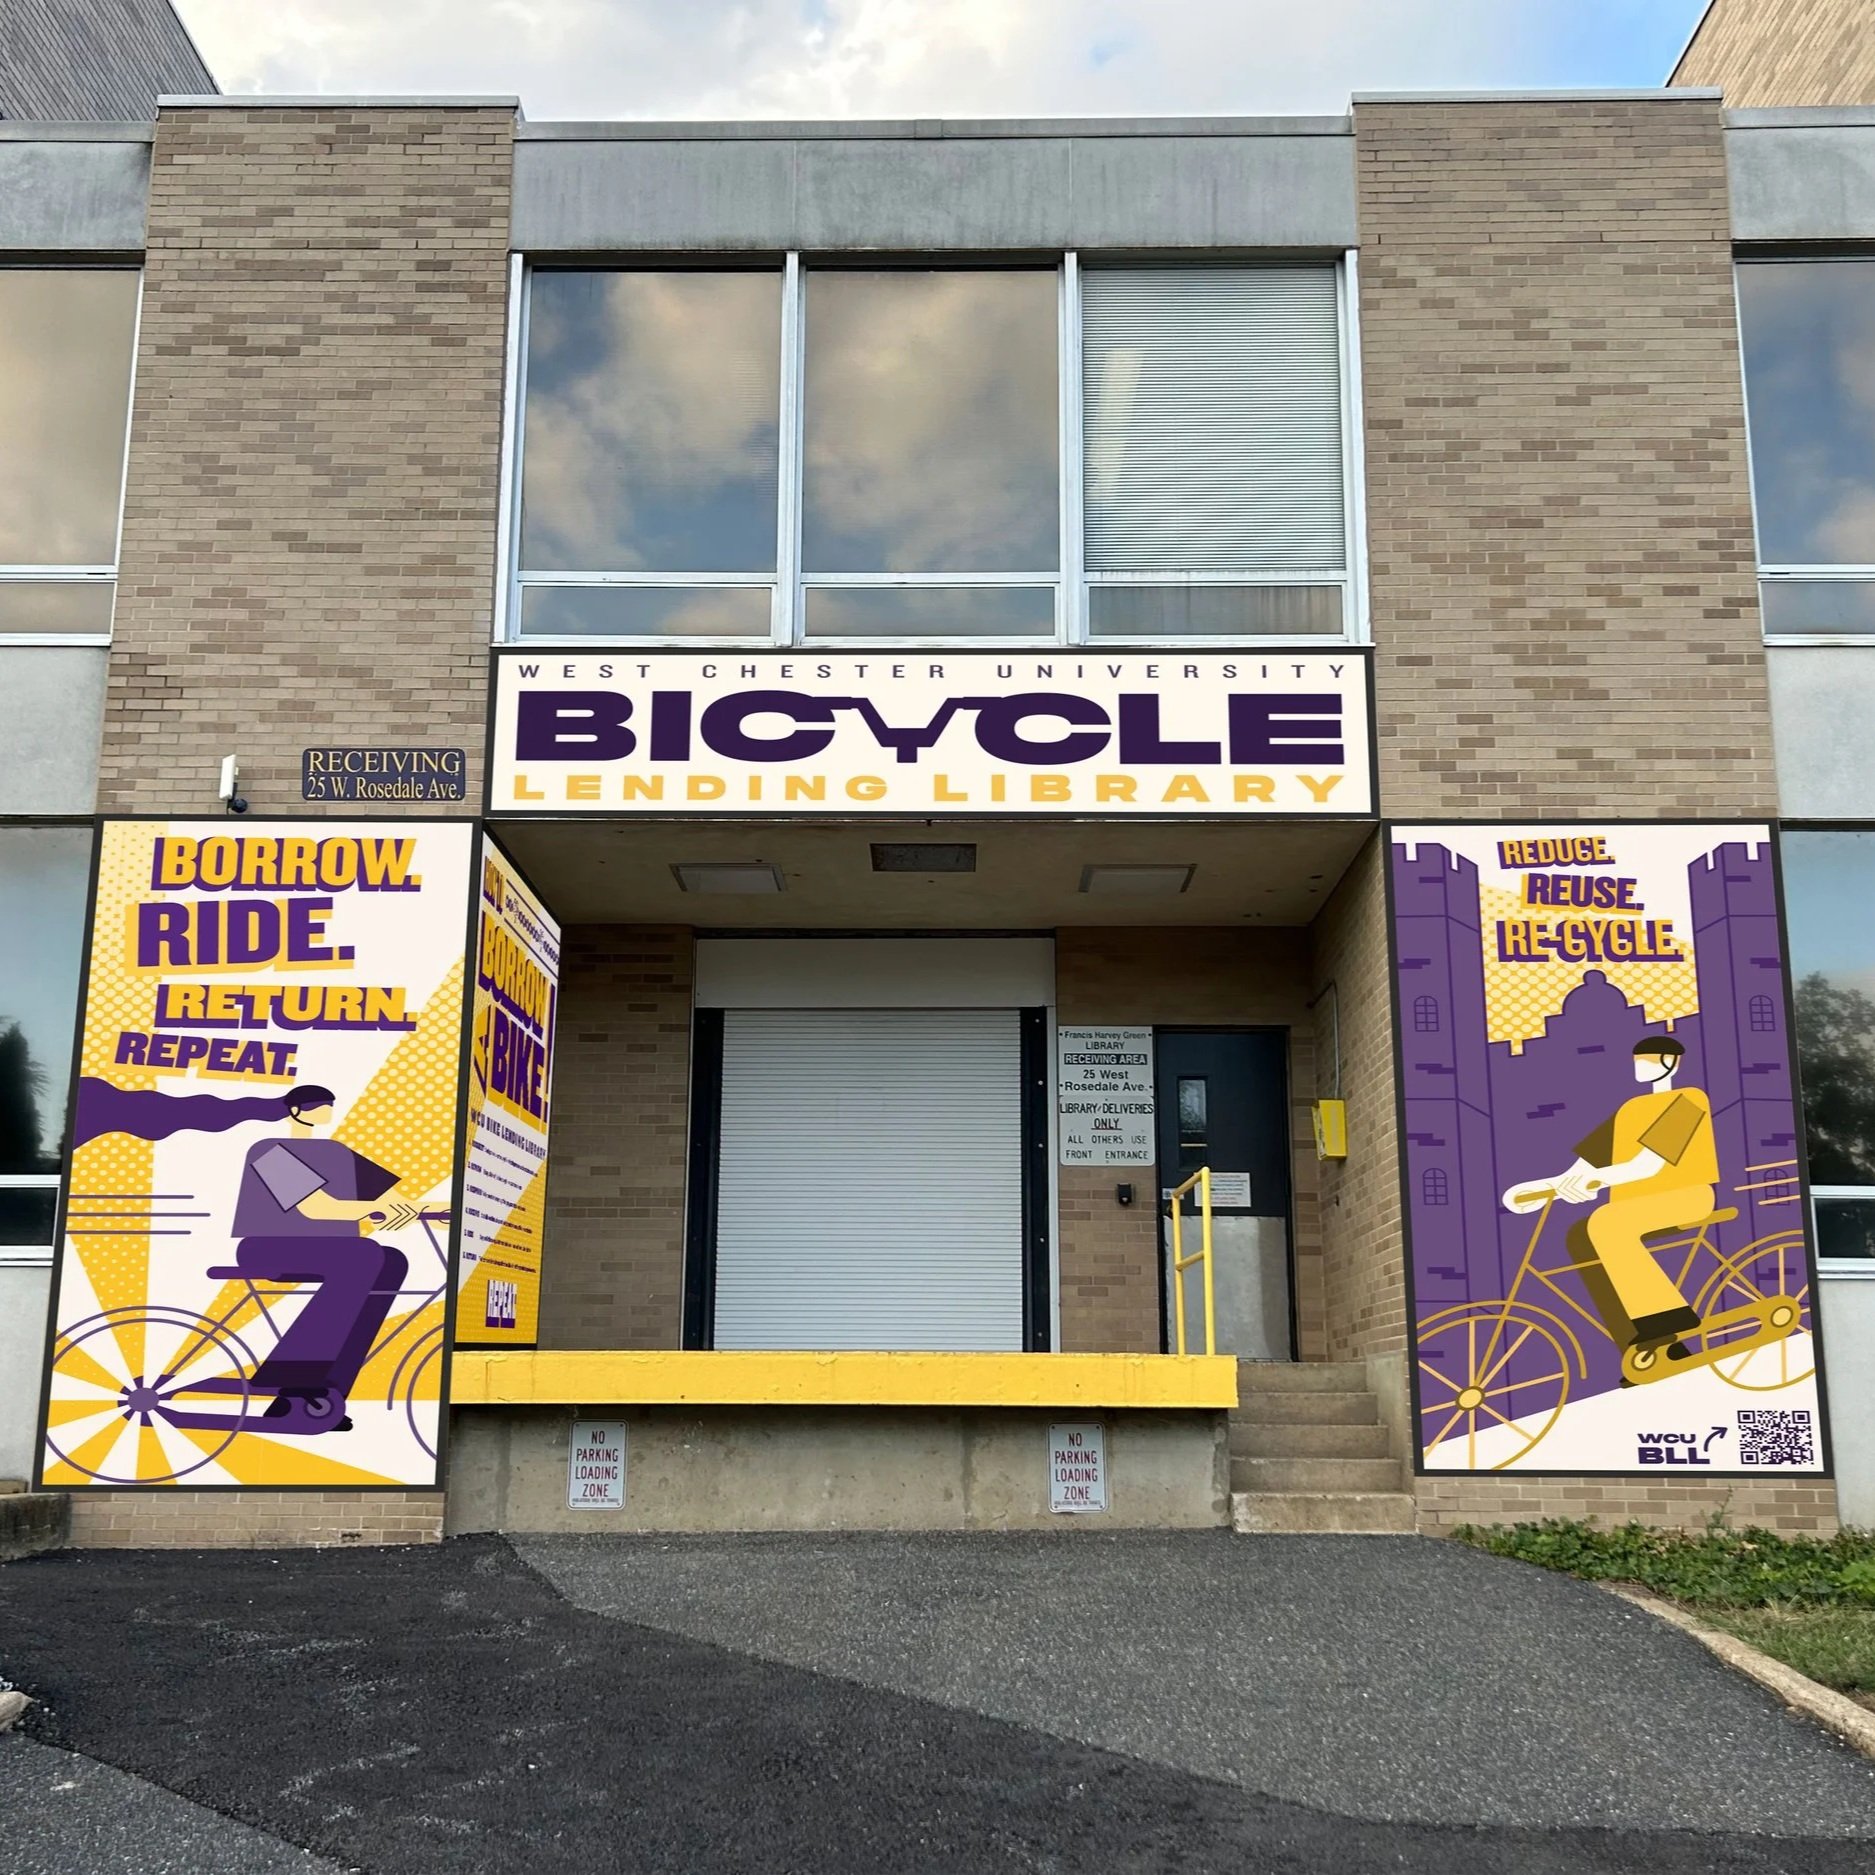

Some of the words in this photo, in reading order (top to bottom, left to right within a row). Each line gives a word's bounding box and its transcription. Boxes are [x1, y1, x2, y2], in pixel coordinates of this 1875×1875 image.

[518, 664, 651, 679] WEST
[702, 664, 945, 679] CHESTER
[997, 664, 1345, 679] UNIVERSITY
[515, 690, 1345, 765] BICYCLE
[307, 751, 461, 774] RECEIVING
[307, 776, 326, 798] 25
[330, 777, 350, 798] W.
[356, 776, 424, 799] Rosedale
[427, 777, 461, 799] Ave.
[513, 774, 888, 801] LENDING
[933, 774, 1345, 802] LIBRARY
[1497, 836, 1616, 869] REDUCE.
[151, 836, 422, 892] BORROW.
[1525, 873, 1645, 912] REUSE.
[134, 897, 356, 970] RIDE.
[1496, 919, 1684, 962] RE-CYCLE.
[478, 911, 550, 1040] BORROW
[154, 983, 418, 1031] RETURN.
[1064, 1031, 1093, 1039] Francis
[1094, 1031, 1121, 1040] Harvey
[1124, 1031, 1146, 1039] Green
[1085, 1042, 1124, 1050] LIBRARY
[113, 1031, 298, 1078] REPEAT.
[1065, 1055, 1117, 1064] RECEIVING
[1119, 1055, 1146, 1064] AREA
[1083, 1070, 1096, 1079] 25
[1100, 1070, 1129, 1080] West
[1064, 1082, 1119, 1091] Rosedale
[1122, 1082, 1148, 1091] Ave.
[1059, 1104, 1099, 1114] LIBRARY
[1102, 1104, 1154, 1114] DELIVERIES
[1094, 1118, 1120, 1129] ONLY
[1067, 1136, 1084, 1144] ALL
[1091, 1135, 1124, 1144] OTHERS
[1131, 1136, 1147, 1144] USE
[1066, 1151, 1093, 1159] FRONT
[1105, 1151, 1149, 1159] ENTRANCE
[591, 1430, 606, 1444] NO
[1068, 1432, 1083, 1446] NO
[1637, 1433, 1696, 1444] WCU
[576, 1448, 619, 1462] PARKING
[1054, 1450, 1097, 1464] PARKING
[1638, 1447, 1710, 1465] BLL
[575, 1466, 618, 1480] LOADING
[1055, 1468, 1098, 1482] LOADING
[582, 1483, 609, 1497] ZONE
[1064, 1486, 1090, 1500] ZONE
